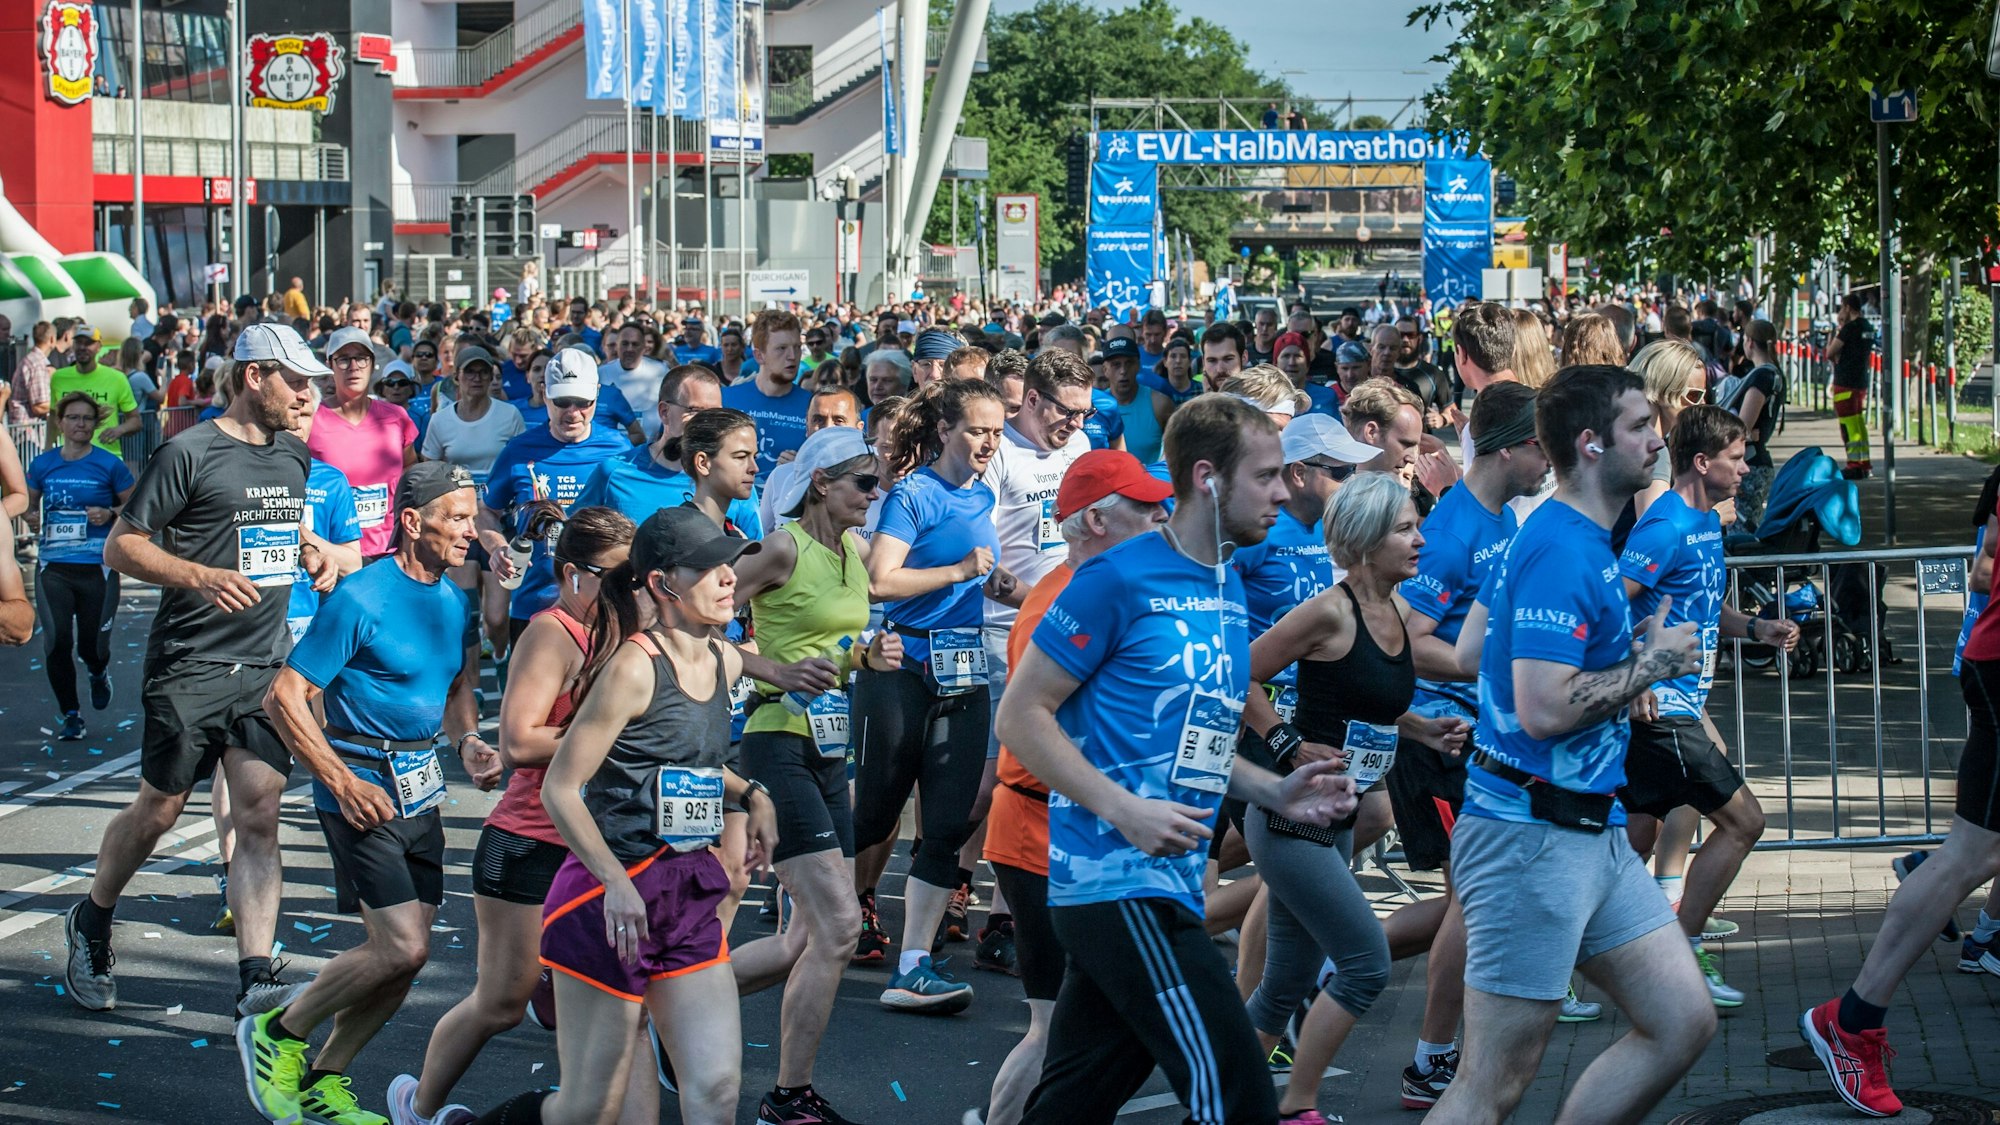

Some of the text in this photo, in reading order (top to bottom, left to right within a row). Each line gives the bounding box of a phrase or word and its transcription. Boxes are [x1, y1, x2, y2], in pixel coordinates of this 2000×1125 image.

[278, 41, 300, 50] 1904
[270, 73, 310, 82] BAYER
[1137, 132, 1445, 161] EVL-HalbMarathon
[751, 272, 808, 282] DURCHGANG
[557, 475, 577, 483] TCS
[245, 486, 290, 499] KRAMPE
[263, 498, 304, 509] SCHMIDT
[233, 509, 300, 522] ARCHITEKTEN
[56, 524, 74, 534] 606
[261, 548, 286, 563] 793
[1513, 607, 1578, 630] HAANER
[953, 650, 975, 664] 408
[1361, 752, 1383, 769] 490
[685, 802, 709, 820] 925
